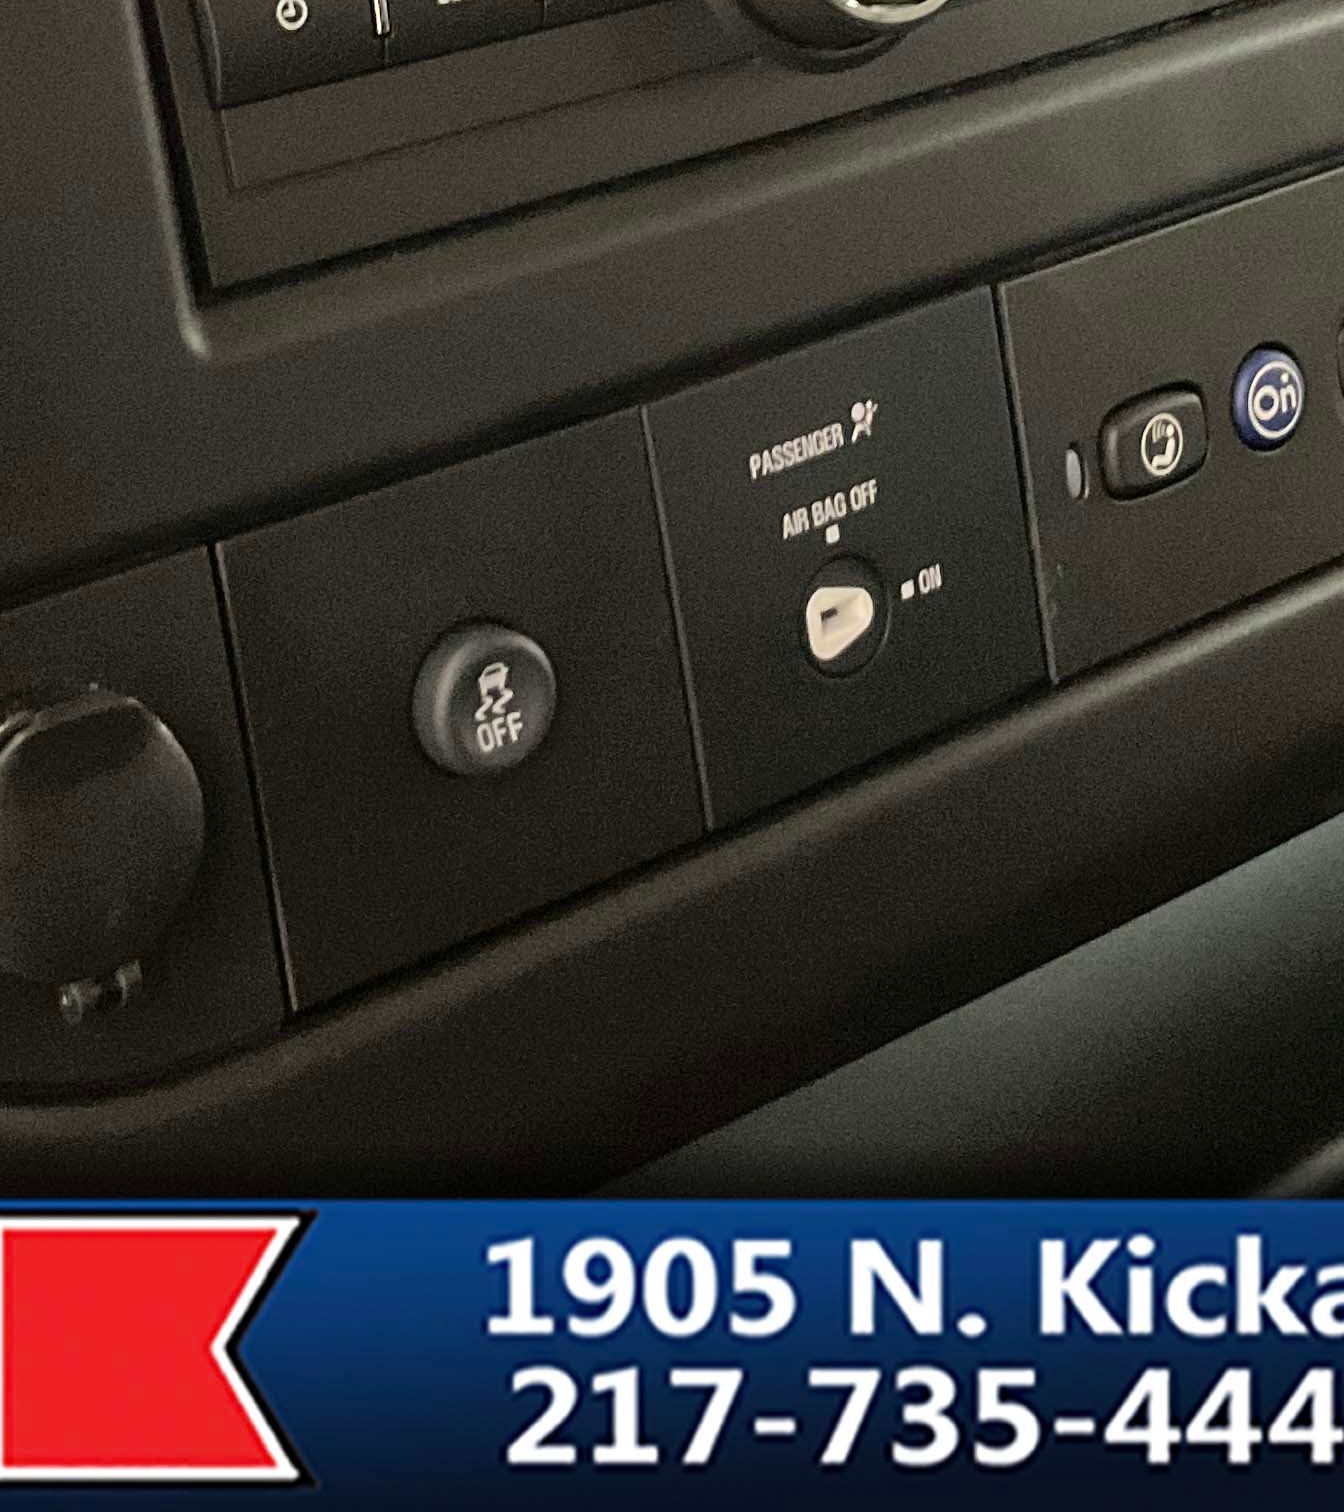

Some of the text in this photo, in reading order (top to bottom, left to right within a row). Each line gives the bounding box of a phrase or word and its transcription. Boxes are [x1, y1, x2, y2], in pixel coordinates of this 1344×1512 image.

[749, 422, 845, 480] PASSENGER
[783, 478, 878, 540] AIR BAG OFF
[918, 562, 942, 595] ON
[476, 710, 523, 753] OFF
